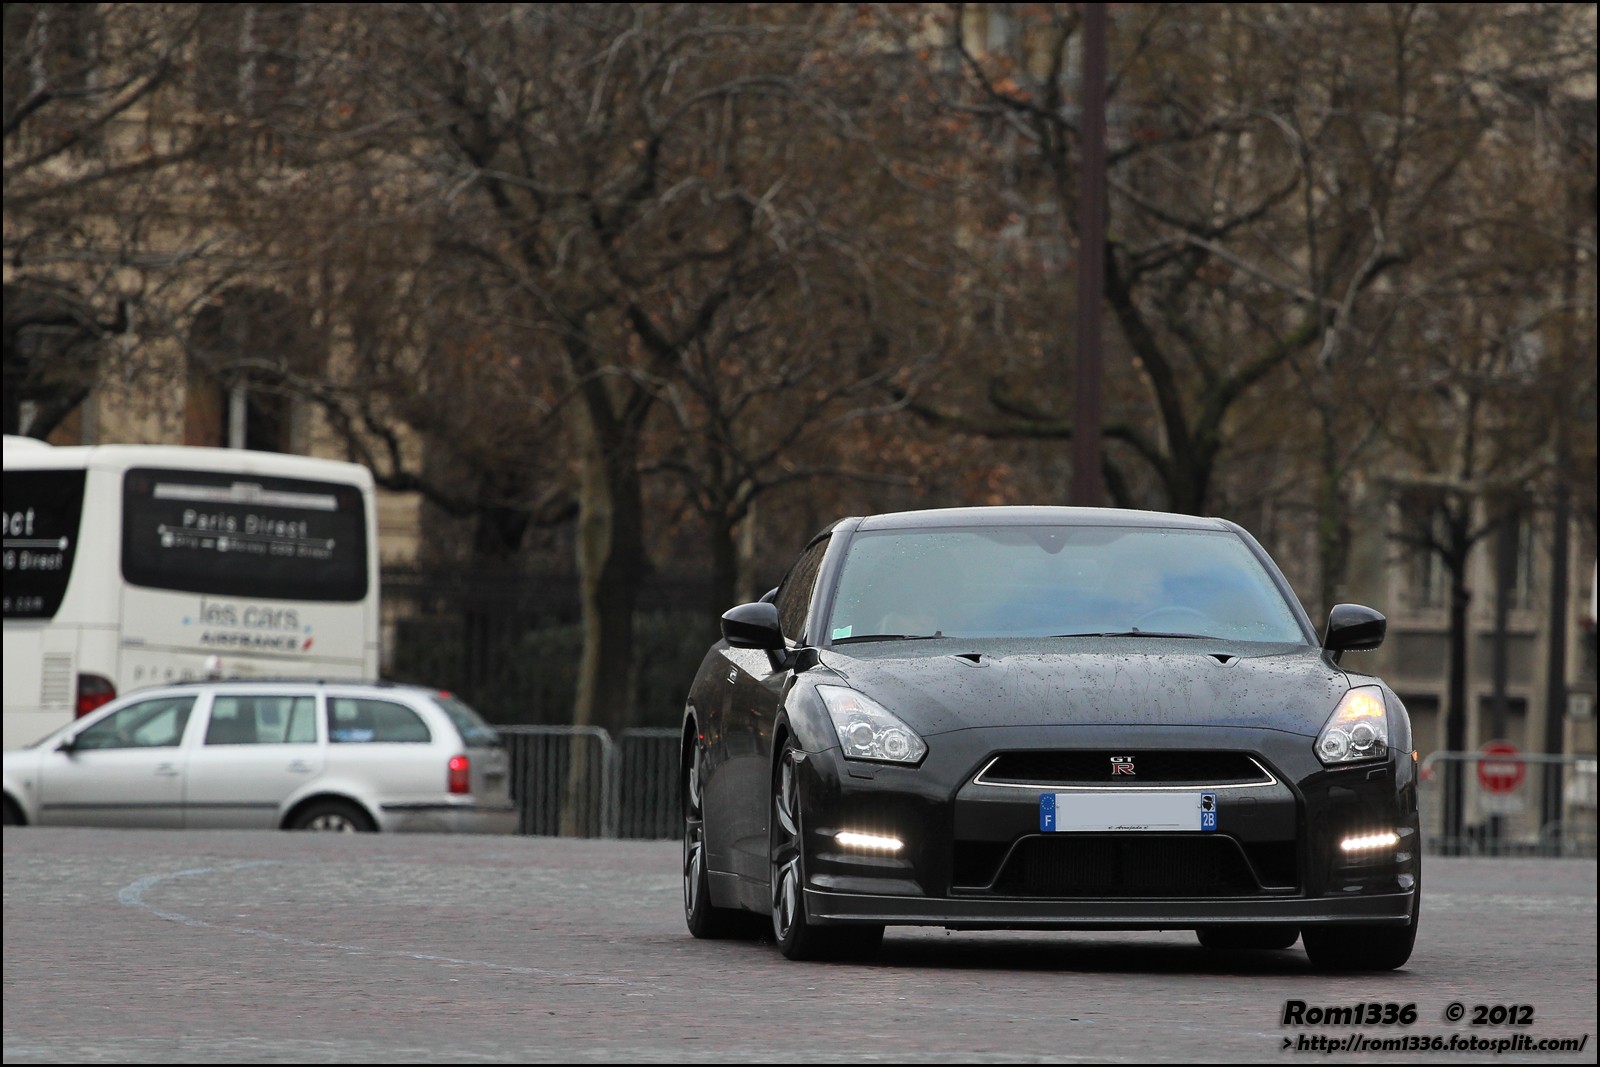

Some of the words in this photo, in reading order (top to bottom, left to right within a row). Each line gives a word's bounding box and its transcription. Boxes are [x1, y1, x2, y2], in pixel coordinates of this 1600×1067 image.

[183, 509, 237, 533] Paris
[245, 514, 307, 538] Direct
[200, 597, 237, 626] les
[243, 605, 298, 631] cars
[1111, 762, 1136, 775] R
[1045, 814, 1052, 827] F
[1203, 812, 1215, 827] 2B
